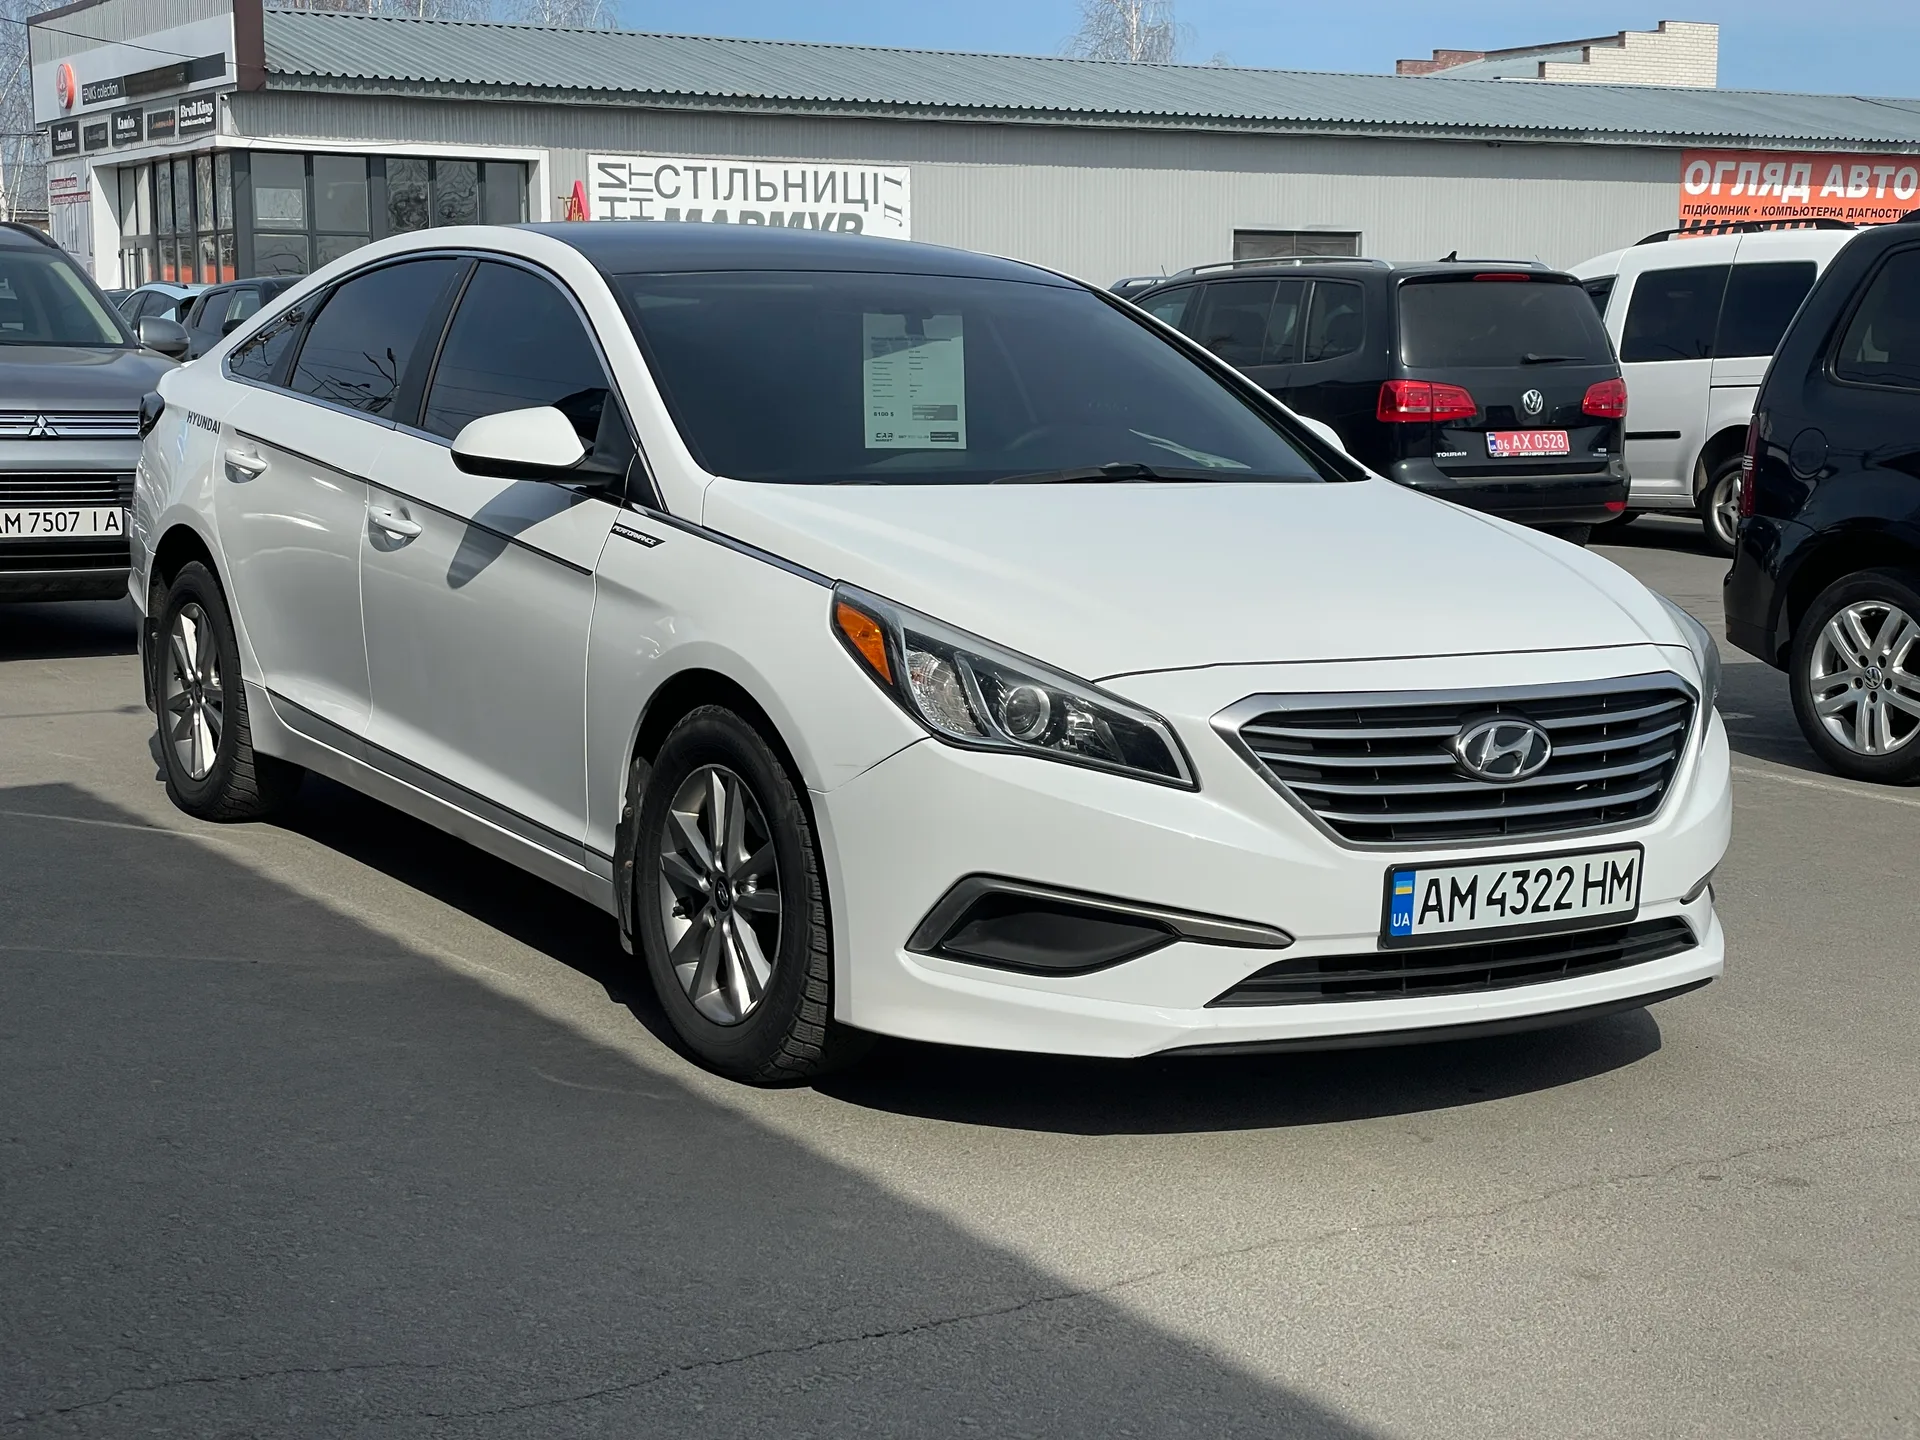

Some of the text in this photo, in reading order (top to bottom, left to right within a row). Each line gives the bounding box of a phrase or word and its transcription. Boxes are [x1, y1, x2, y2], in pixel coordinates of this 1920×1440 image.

[654, 164, 879, 213] СТІЛЬНИЦІ
[1684, 159, 1919, 204] ОГЛЯД АВТО
[1682, 202, 1751, 216] ПІДЙОМНИК
[187, 410, 221, 434] HYUNDAI
[1497, 433, 1565, 450] 06 AX 0528
[28, 511, 80, 534] 7507
[93, 511, 119, 532] IA
[1418, 858, 1635, 925] AM 4322 HM
[1393, 913, 1410, 927] UA
